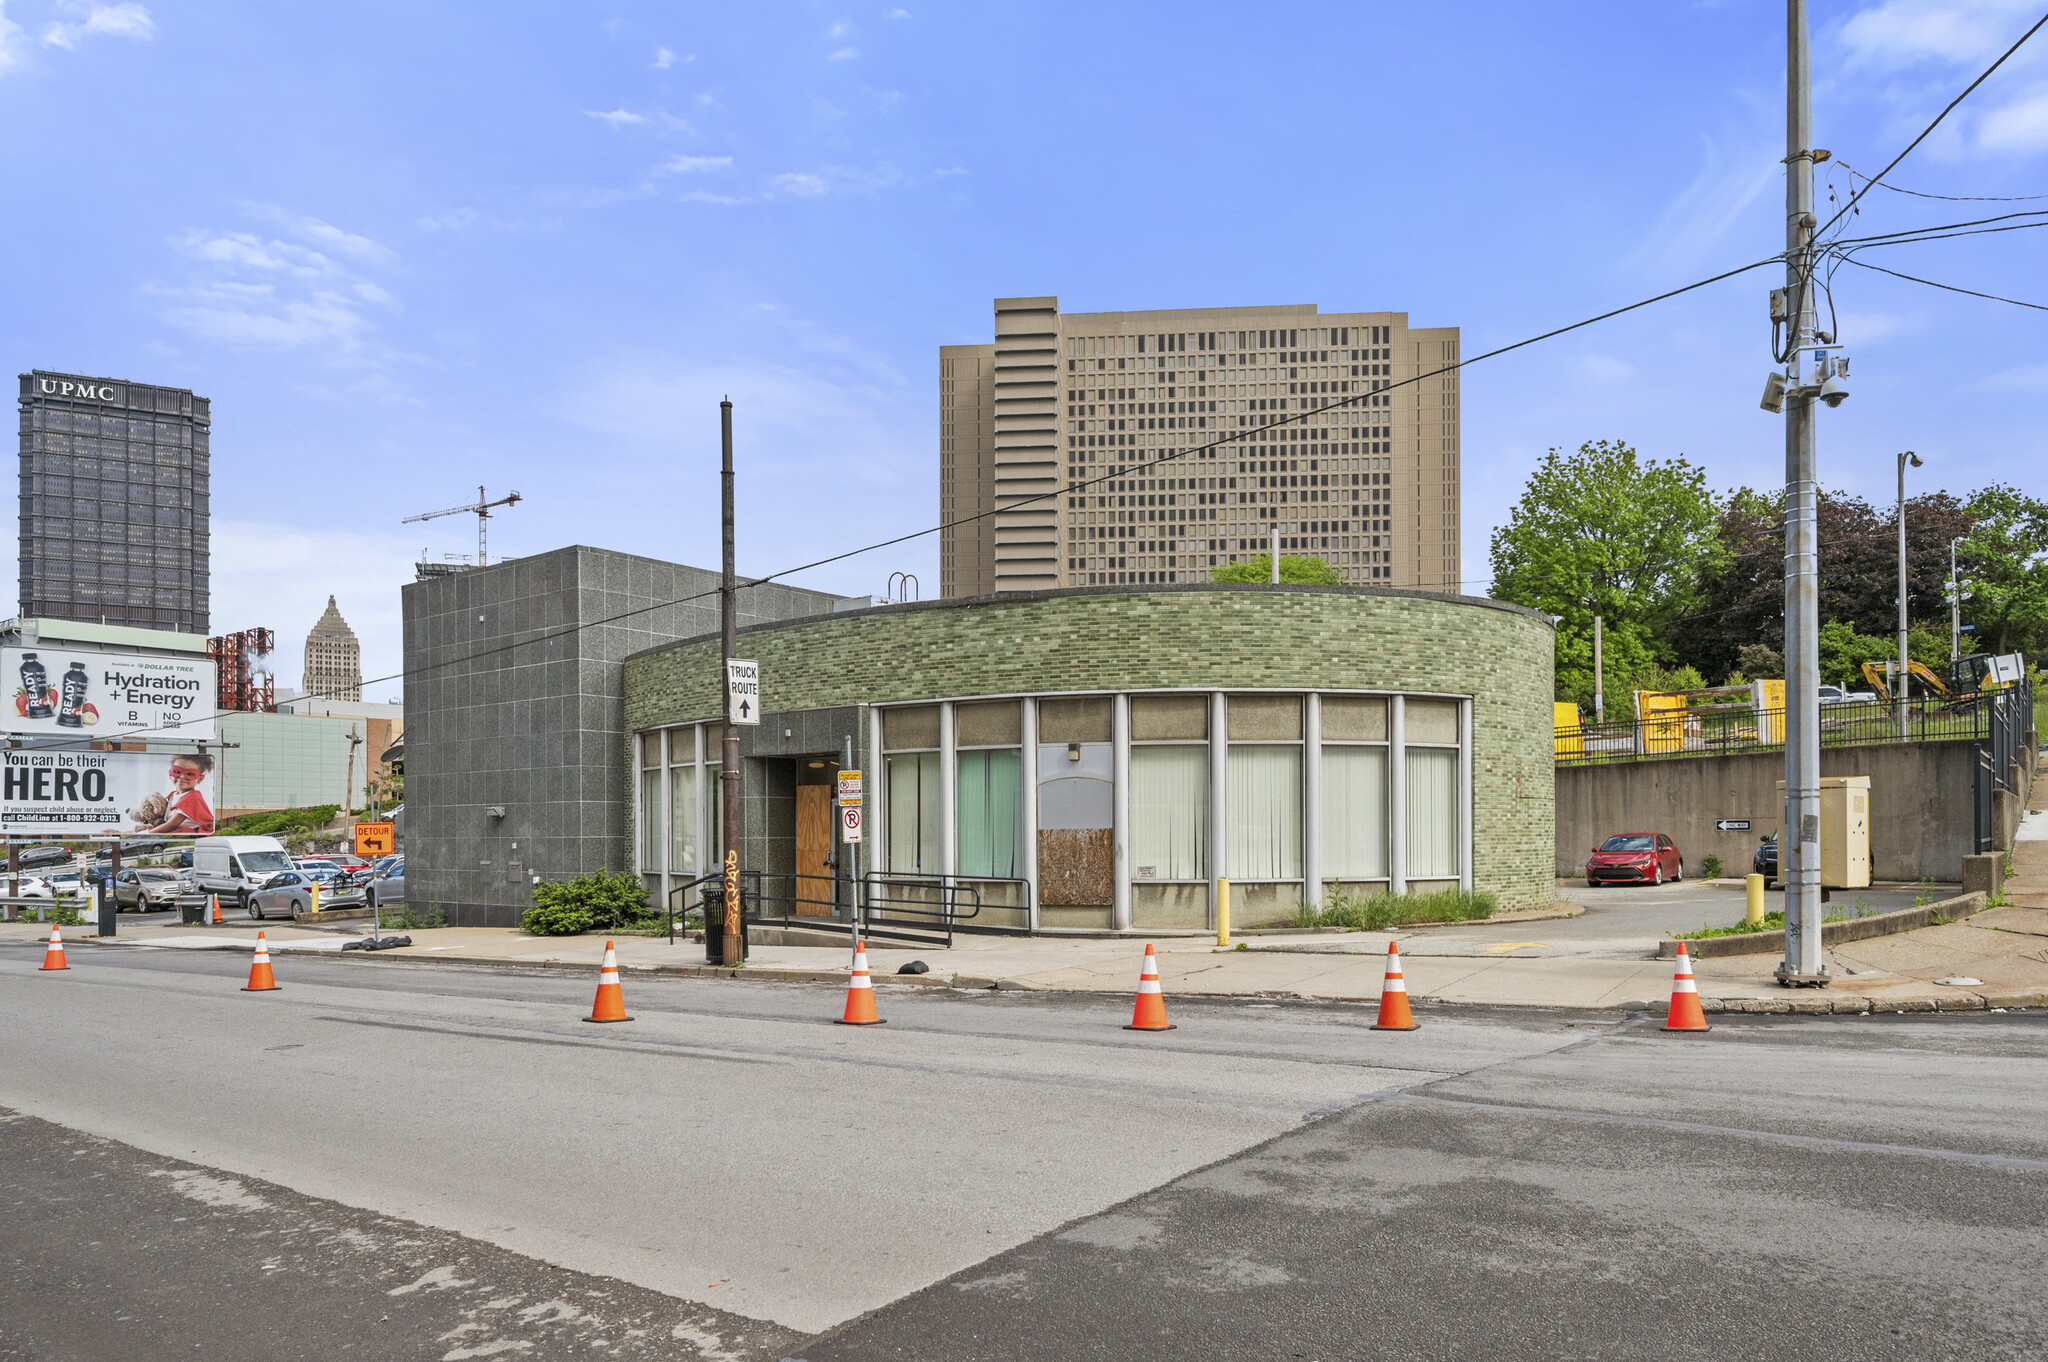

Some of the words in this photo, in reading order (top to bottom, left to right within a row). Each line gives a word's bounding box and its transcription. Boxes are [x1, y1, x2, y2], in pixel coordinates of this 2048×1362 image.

[40, 379, 114, 401] UPMC
[144, 663, 174, 671] DOLLAR
[730, 665, 757, 679] TRUCK
[104, 671, 200, 690] Hydration
[22, 670, 39, 707] READY
[732, 681, 757, 695] ROUTE
[62, 677, 76, 715] READY
[109, 690, 121, 701] +
[127, 689, 195, 710] Energy
[128, 710, 138, 720] B
[163, 712, 181, 721] NO
[3, 751, 28, 765] You
[31, 755, 53, 766] can
[58, 753, 73, 766] be
[76, 754, 107, 767] their
[4, 766, 114, 802] HERO.
[23, 806, 48, 814] suspect
[49, 805, 65, 813] child
[3, 814, 16, 822] call
[16, 814, 50, 822] ChildLine
[358, 827, 390, 836] DETOUR
